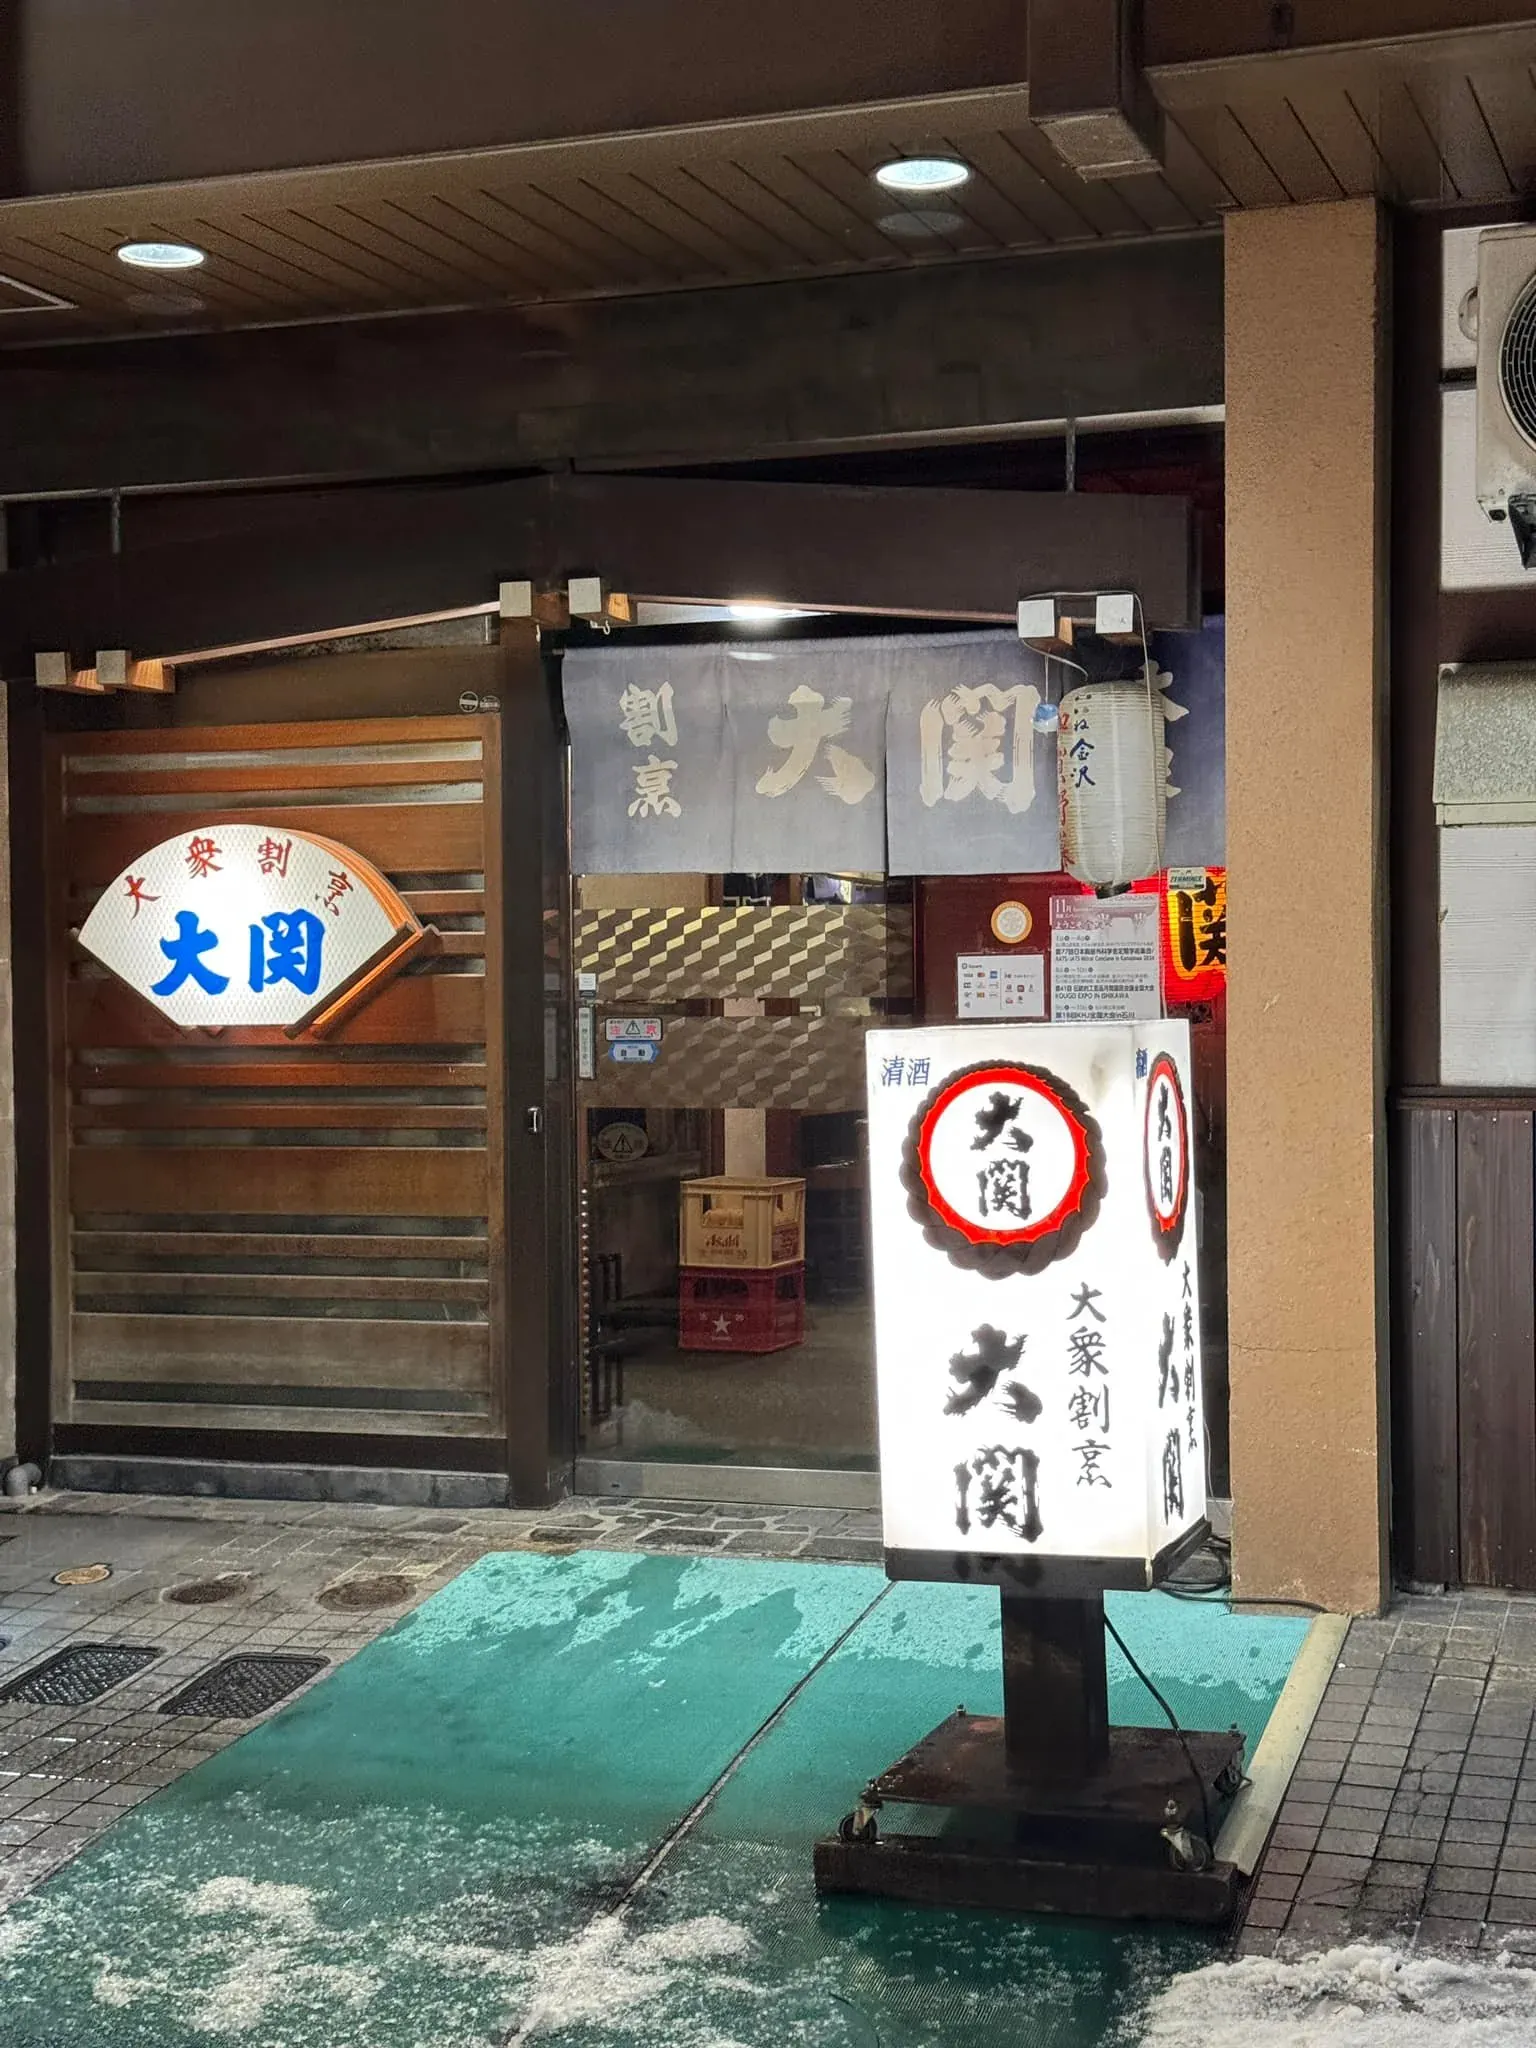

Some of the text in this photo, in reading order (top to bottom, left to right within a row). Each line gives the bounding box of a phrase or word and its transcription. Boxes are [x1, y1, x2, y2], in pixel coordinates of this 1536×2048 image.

[619, 681, 682, 818] 割烹
[755, 683, 1042, 814] 大関
[124, 836, 353, 920] 大衆割烹
[150, 908, 326, 996] 大関
[880, 1056, 931, 1088] 清酒
[969, 1091, 1033, 1220] 大関
[706, 1233, 740, 1248] Asahi
[943, 1322, 1044, 1543] 大関
[1065, 1281, 1113, 1489] 大衆割烹
